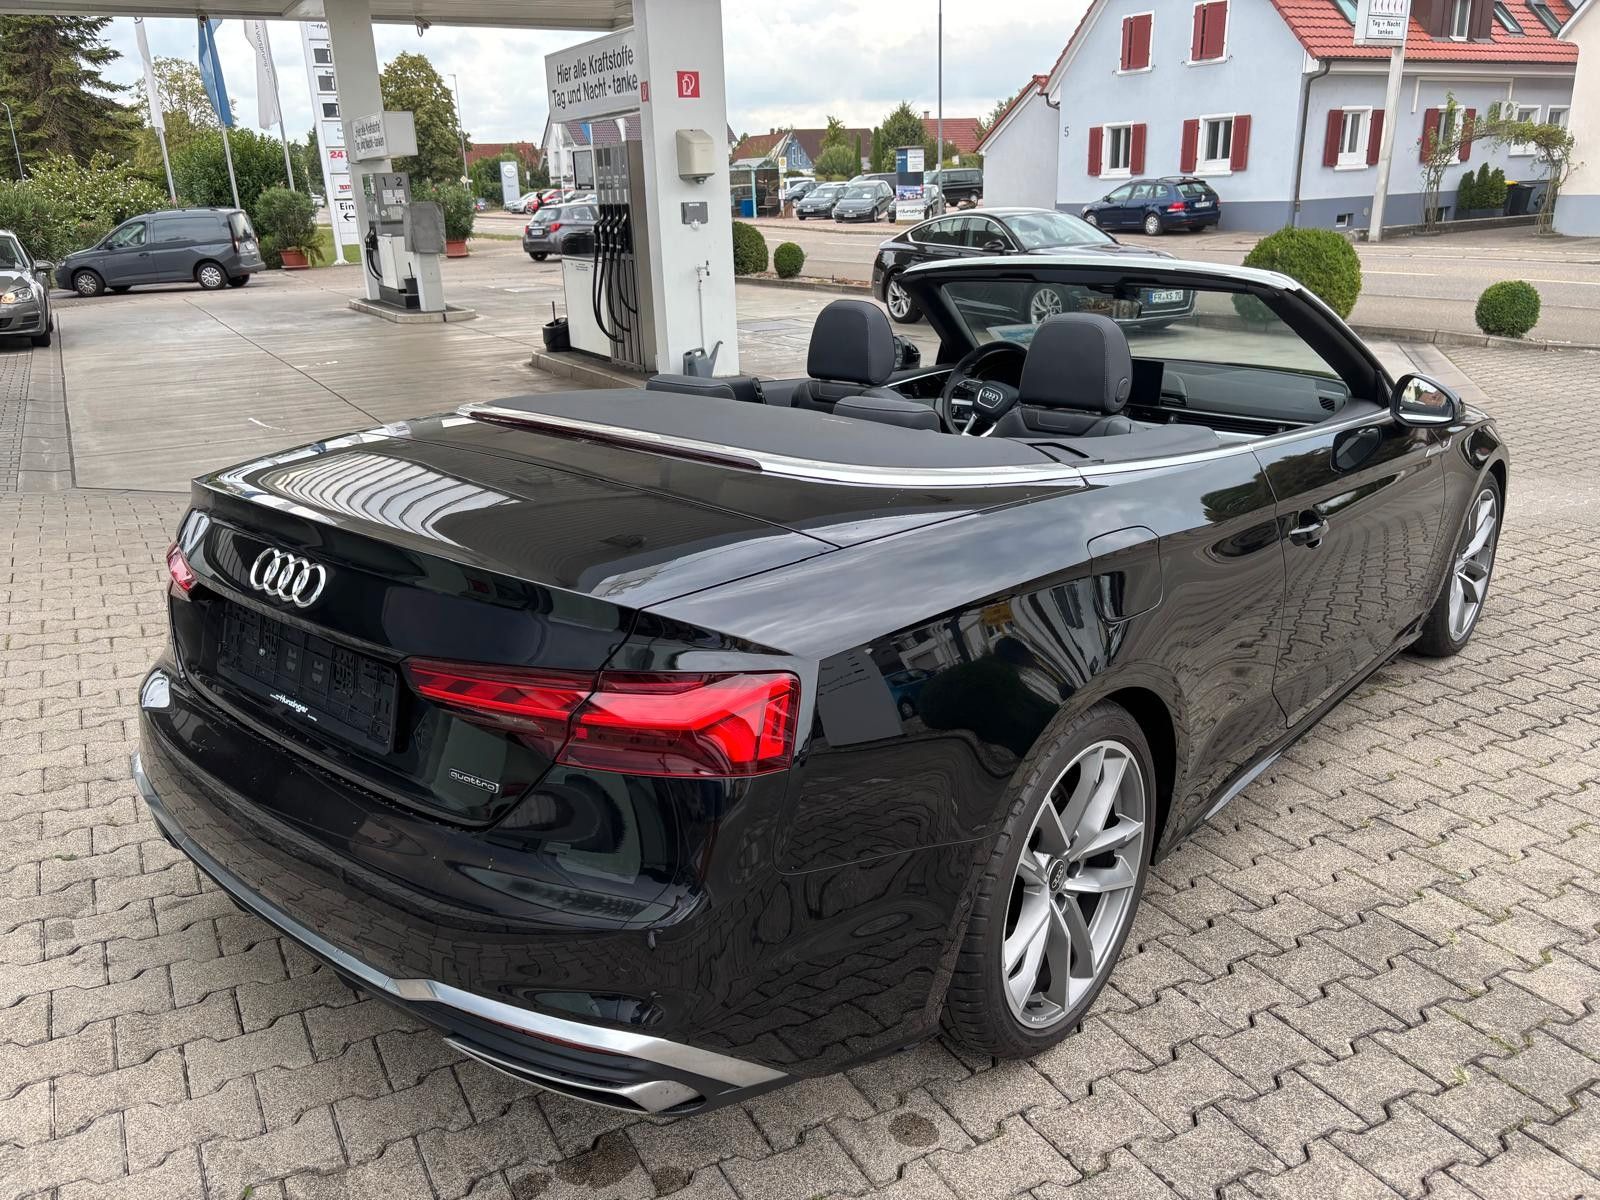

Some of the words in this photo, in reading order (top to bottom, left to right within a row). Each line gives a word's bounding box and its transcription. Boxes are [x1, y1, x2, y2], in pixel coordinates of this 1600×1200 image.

[556, 64, 571, 84] Hier
[573, 58, 587, 80] alle
[588, 44, 634, 75] Kraftstoffe
[552, 89, 566, 109] Tag
[567, 84, 582, 104] und
[583, 76, 607, 101] Nacht
[612, 70, 638, 94] tanke
[1064, 126, 1069, 137] 5
[330, 150, 343, 158] 24
[383, 177, 387, 187] 1
[395, 177, 403, 187] 2
[340, 202, 355, 210] Ein
[450, 771, 495, 791] quattro
